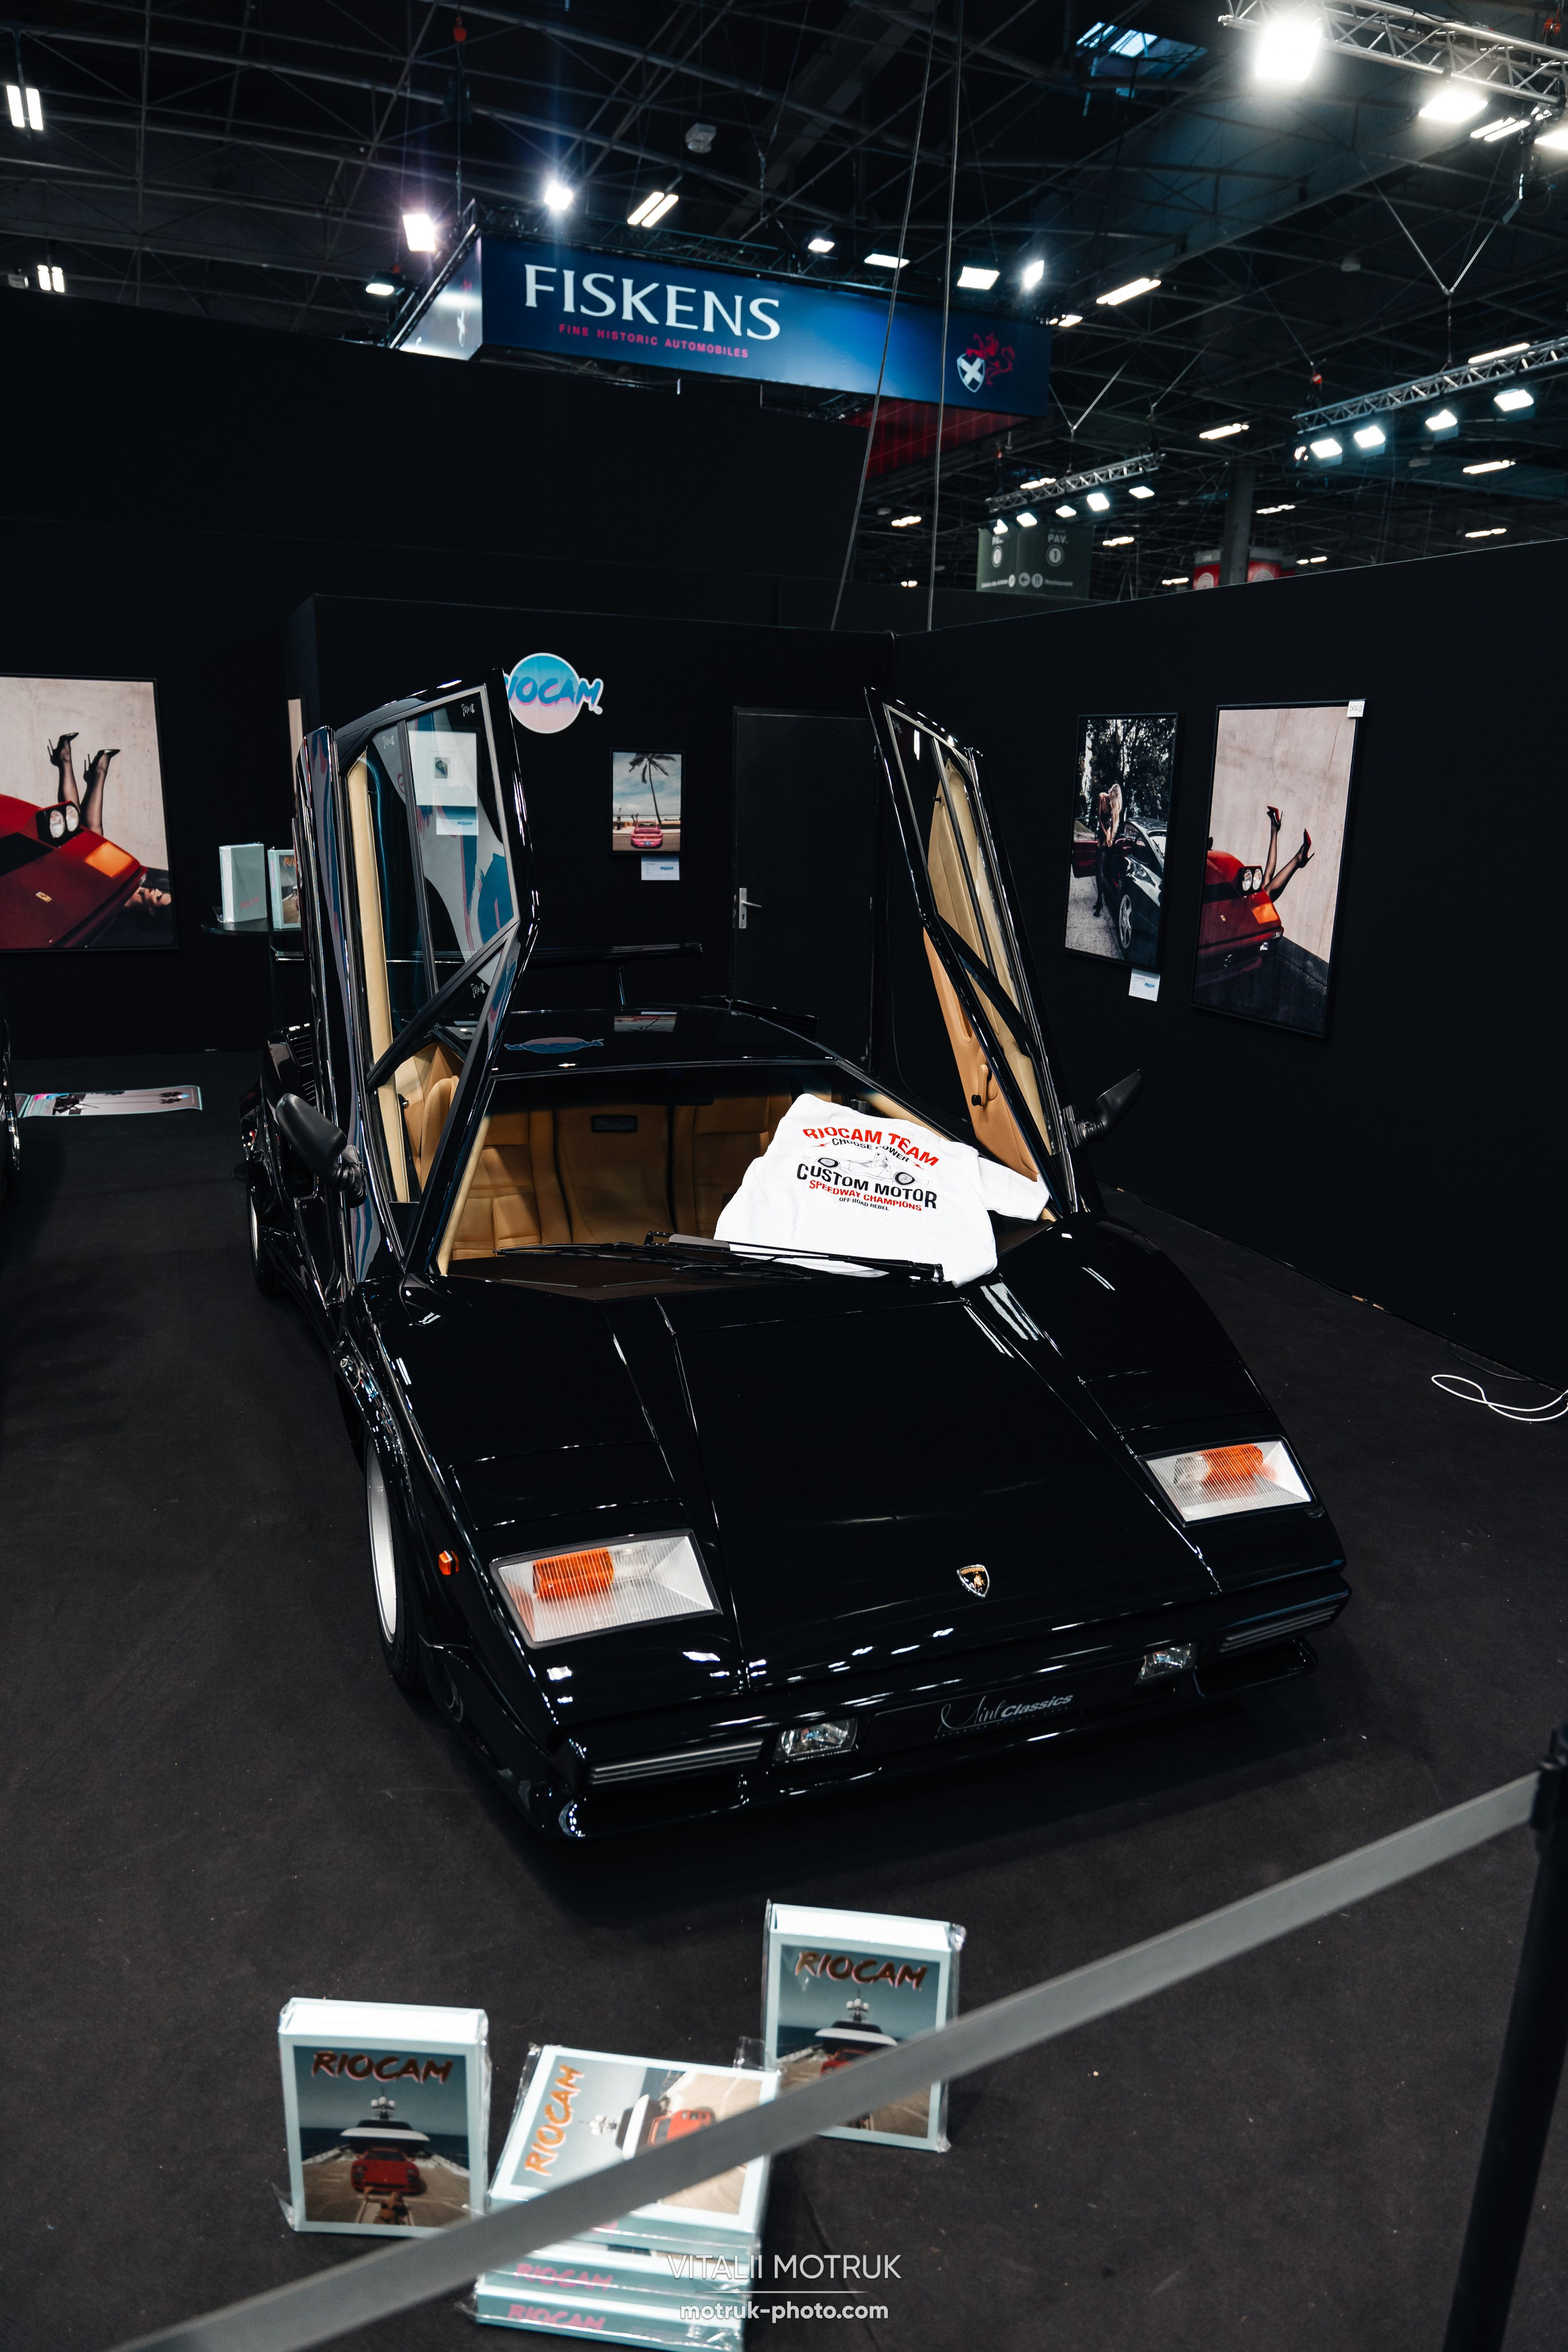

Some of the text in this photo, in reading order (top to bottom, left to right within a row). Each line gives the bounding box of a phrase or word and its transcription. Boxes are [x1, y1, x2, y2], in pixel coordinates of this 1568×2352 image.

[525, 264, 781, 341] FISKENS
[559, 324, 748, 358] FINE HISTORIC AUTOMOBILES
[802, 1127, 940, 1167] RIOCAM TEAM
[832, 1138, 873, 1150] CHOOSE
[796, 1163, 938, 1209] CUSTOM MOTOR
[809, 1180, 922, 1212] SPEEDWAY CHAMPIONS
[852, 1198, 869, 1207] ROAD
[794, 1951, 928, 1989] RIOCAM
[311, 2051, 453, 2084] RIOCAM
[524, 2064, 586, 2177] RIOCAM
[514, 2263, 614, 2292] RIOCAM
[507, 2304, 606, 2330] RIOCAM
